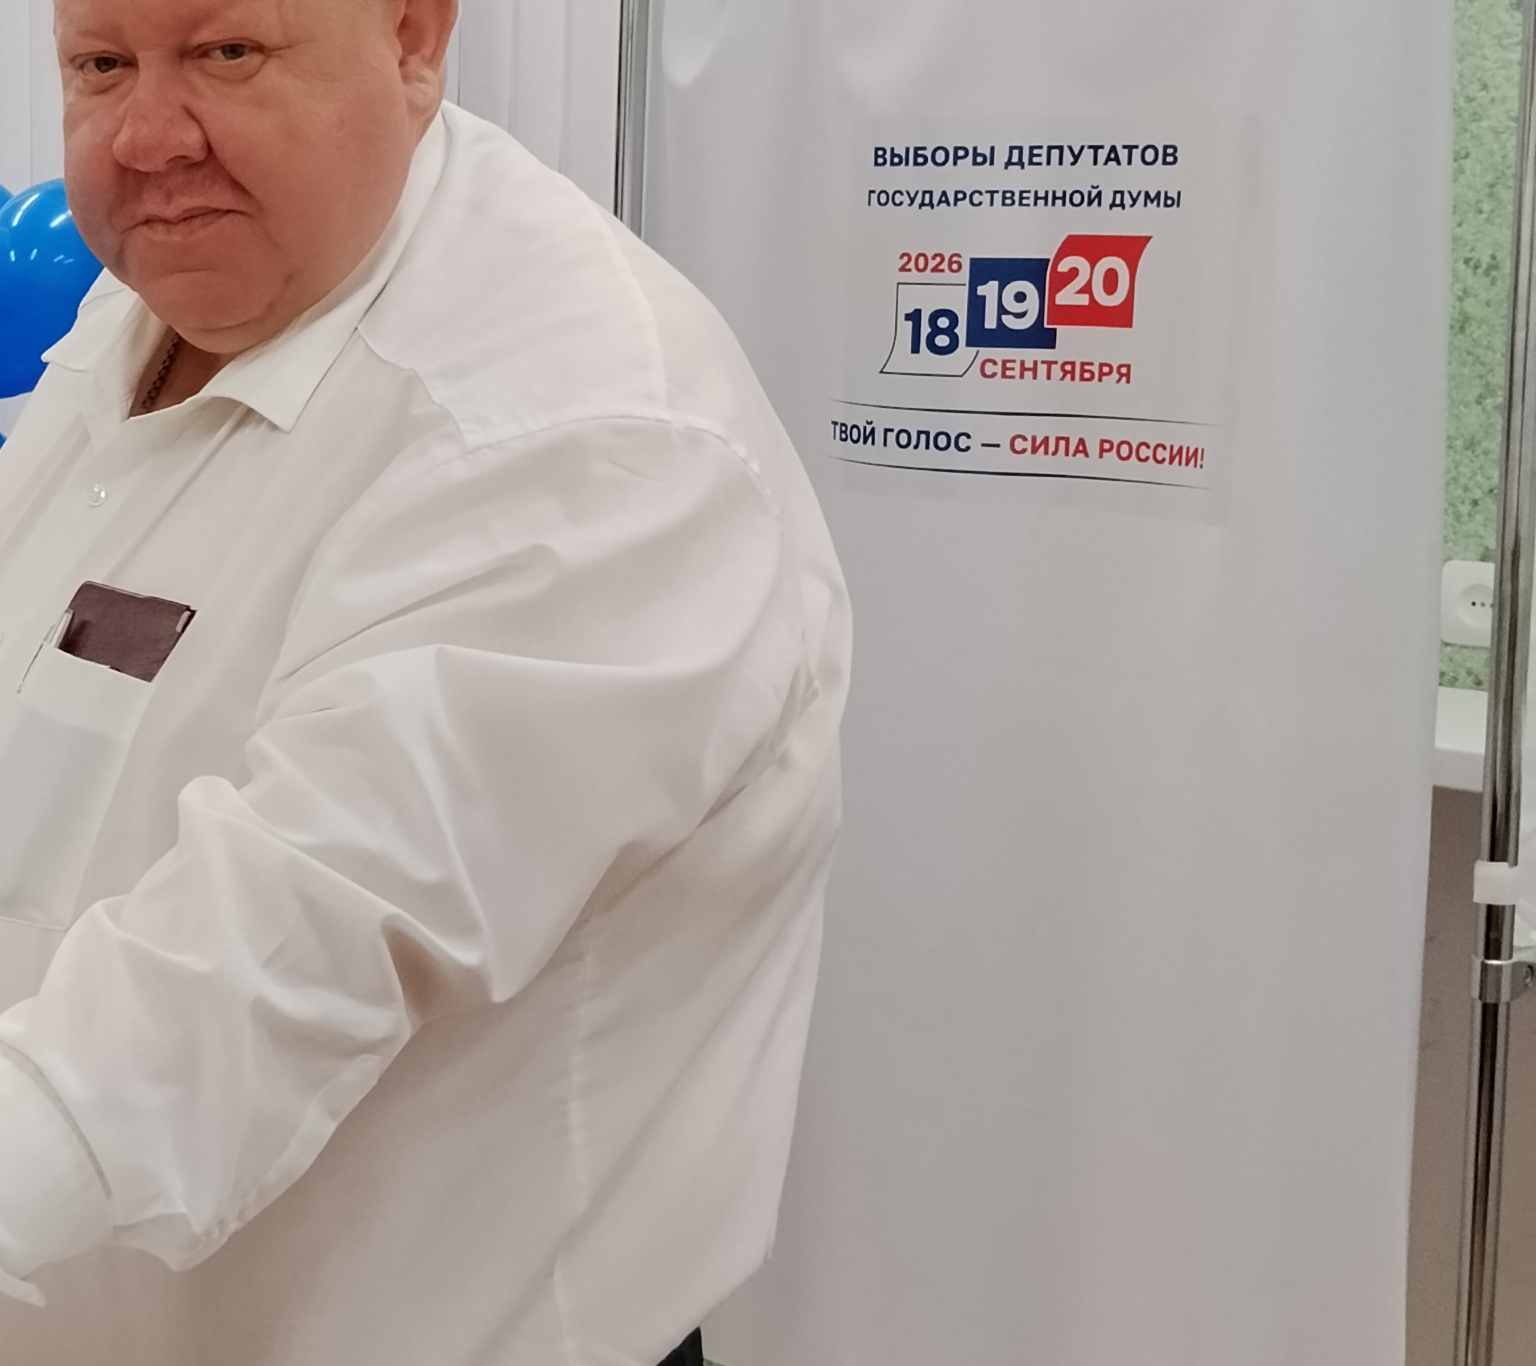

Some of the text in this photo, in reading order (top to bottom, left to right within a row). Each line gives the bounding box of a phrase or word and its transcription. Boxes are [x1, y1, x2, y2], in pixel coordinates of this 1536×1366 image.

[873, 144, 1179, 170] ВЫБОРЫ ДЕПУТАТОВ
[867, 184, 1182, 211] ГОСУДАРСТВЕННОЙ ДУМЫ
[897, 252, 964, 275] 2026
[904, 255, 1131, 356] 18 19 20
[979, 358, 1132, 385] СЕНТЯБРЯ
[830, 419, 876, 447] ТВОЙ
[882, 427, 973, 453] ГОЛОС
[1009, 434, 1091, 459] СИЛА
[1098, 438, 1206, 469] РОССИИ!
